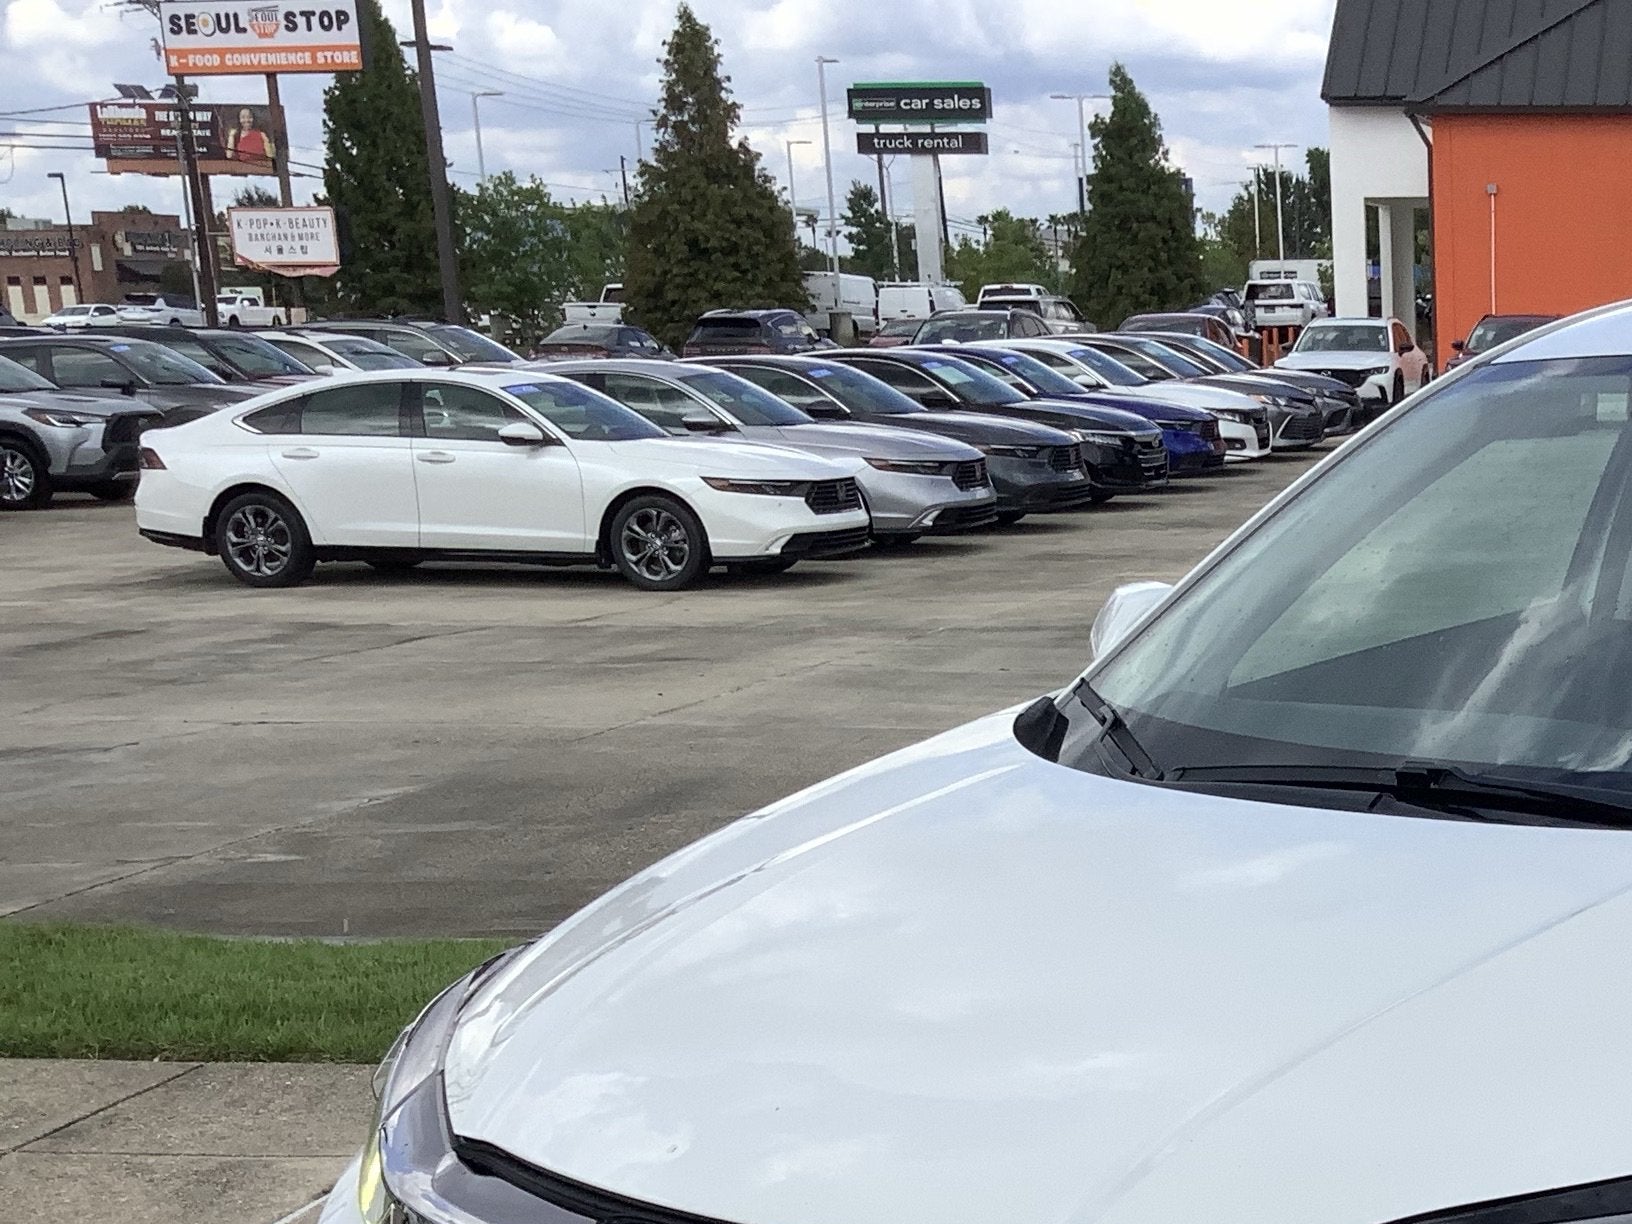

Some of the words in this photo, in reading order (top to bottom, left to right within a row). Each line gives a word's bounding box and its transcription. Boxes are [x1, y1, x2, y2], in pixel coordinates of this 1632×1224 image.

[169, 12, 248, 37] SEOUL
[283, 10, 350, 33] STOP
[170, 54, 220, 68] K-FOOD
[225, 52, 312, 66] CONVENIENCE
[316, 50, 359, 64] STORE
[900, 98, 929, 109] car
[933, 94, 982, 110] sales
[874, 135, 912, 149] truck
[918, 134, 963, 149] rental
